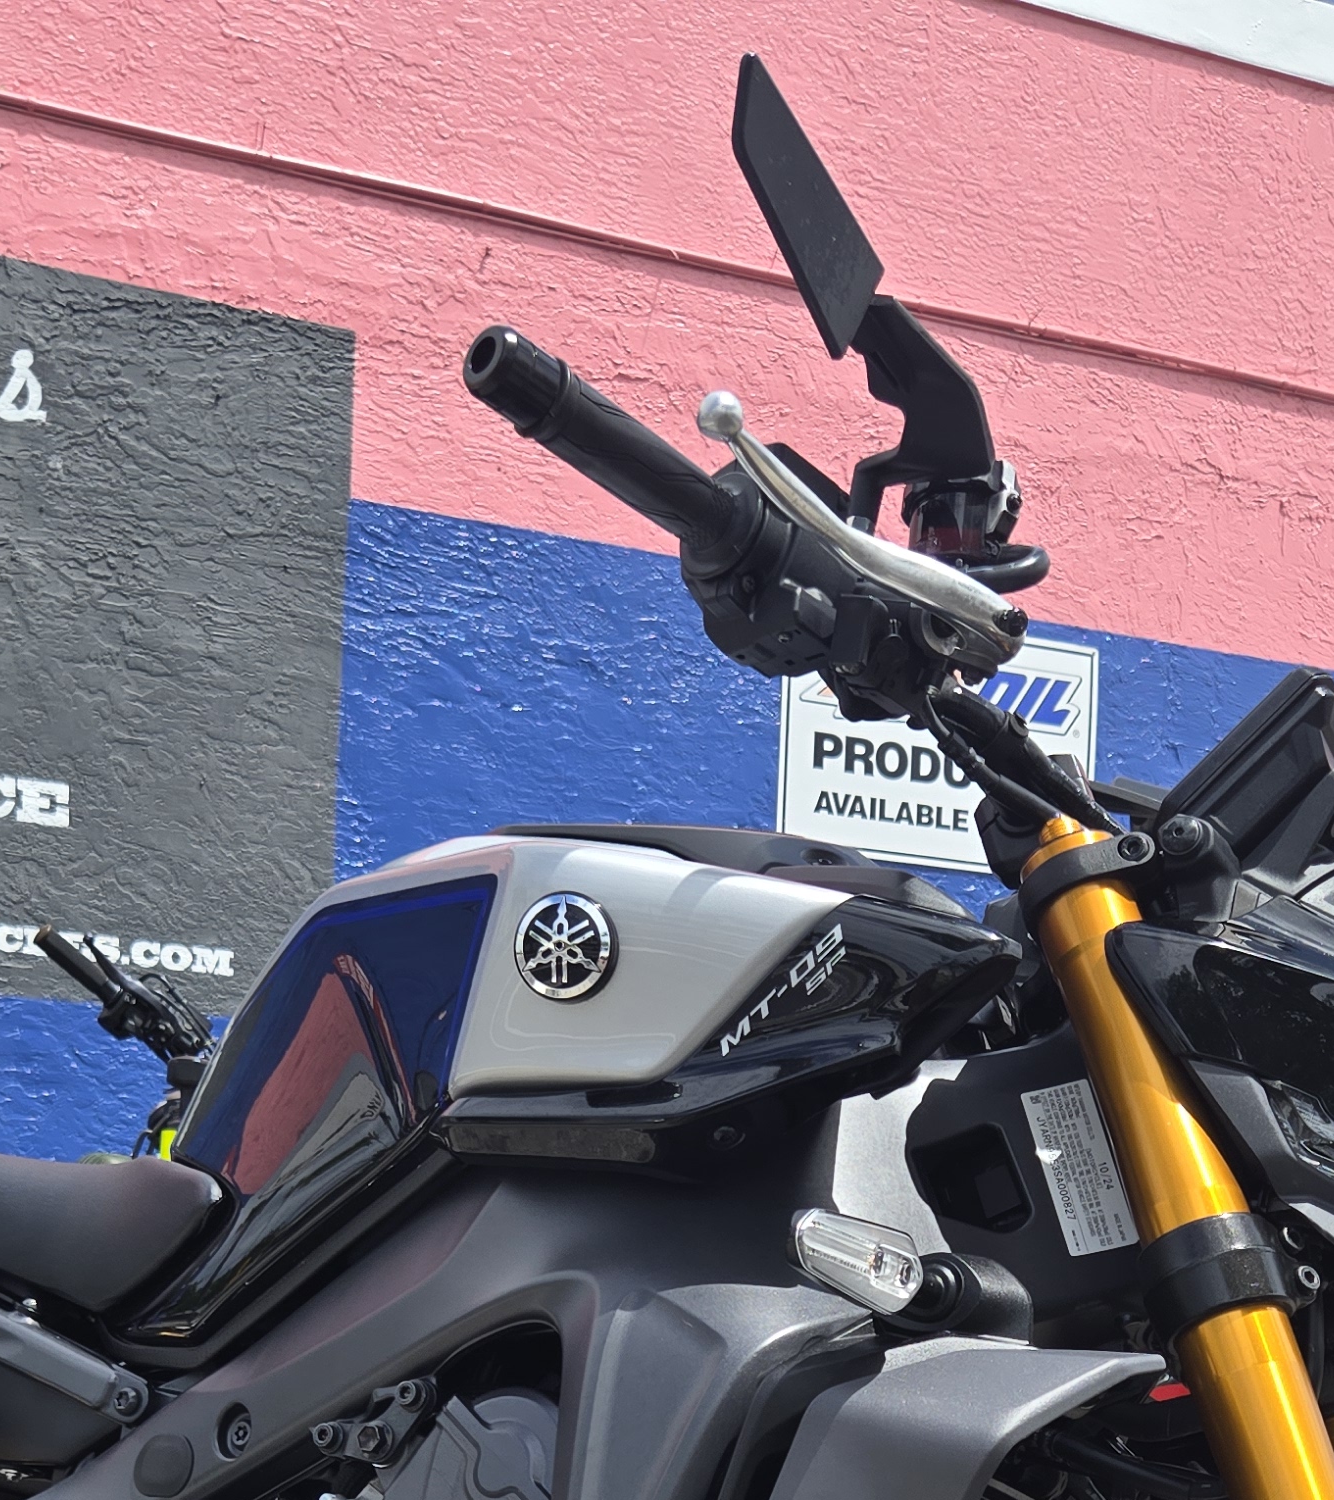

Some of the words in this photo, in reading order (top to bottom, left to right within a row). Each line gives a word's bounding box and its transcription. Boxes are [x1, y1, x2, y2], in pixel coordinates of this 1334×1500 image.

[812, 731, 971, 789] PRODU
[813, 790, 969, 832] AVAILABLE
[720, 923, 844, 1057] MT-09
[805, 946, 847, 996] SP
[1098, 1161, 1115, 1191] 10/24
